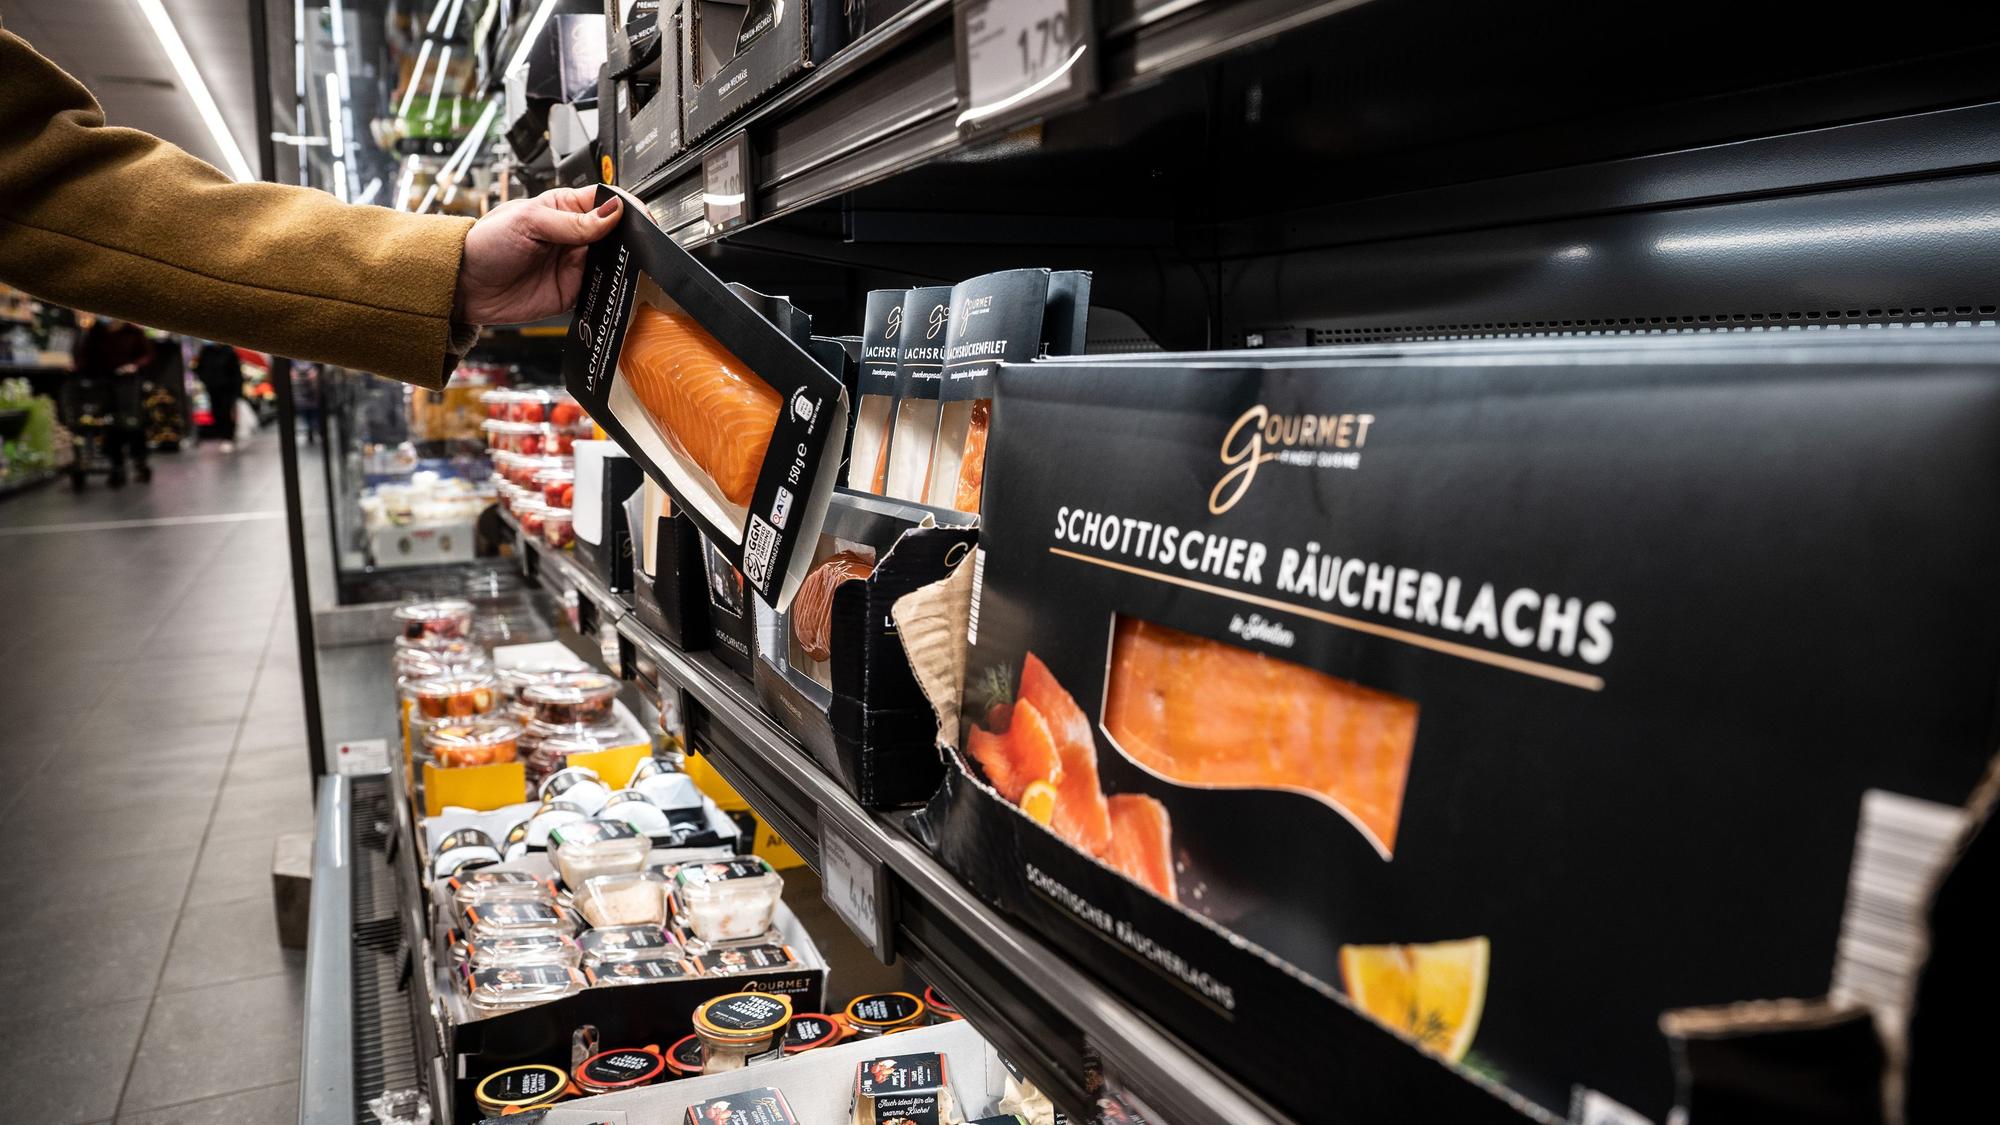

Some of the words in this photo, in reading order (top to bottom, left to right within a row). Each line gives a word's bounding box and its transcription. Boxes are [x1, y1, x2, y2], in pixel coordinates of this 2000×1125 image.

[586, 244, 626, 392] LACHSRÜCKENFILET
[885, 306, 904, 339] G
[866, 346, 900, 358] LACHSR
[788, 466, 800, 485] 150
[798, 457, 806, 469] g
[1208, 404, 1375, 515] GOURMET
[749, 520, 761, 551] GGN
[760, 530, 770, 559] FARMING
[1054, 506, 1267, 585] SCHOTTISCHER
[1277, 543, 1617, 666] RÄUCHERLACHS
[1115, 914, 1236, 1010] RÄUCHERLACHS
